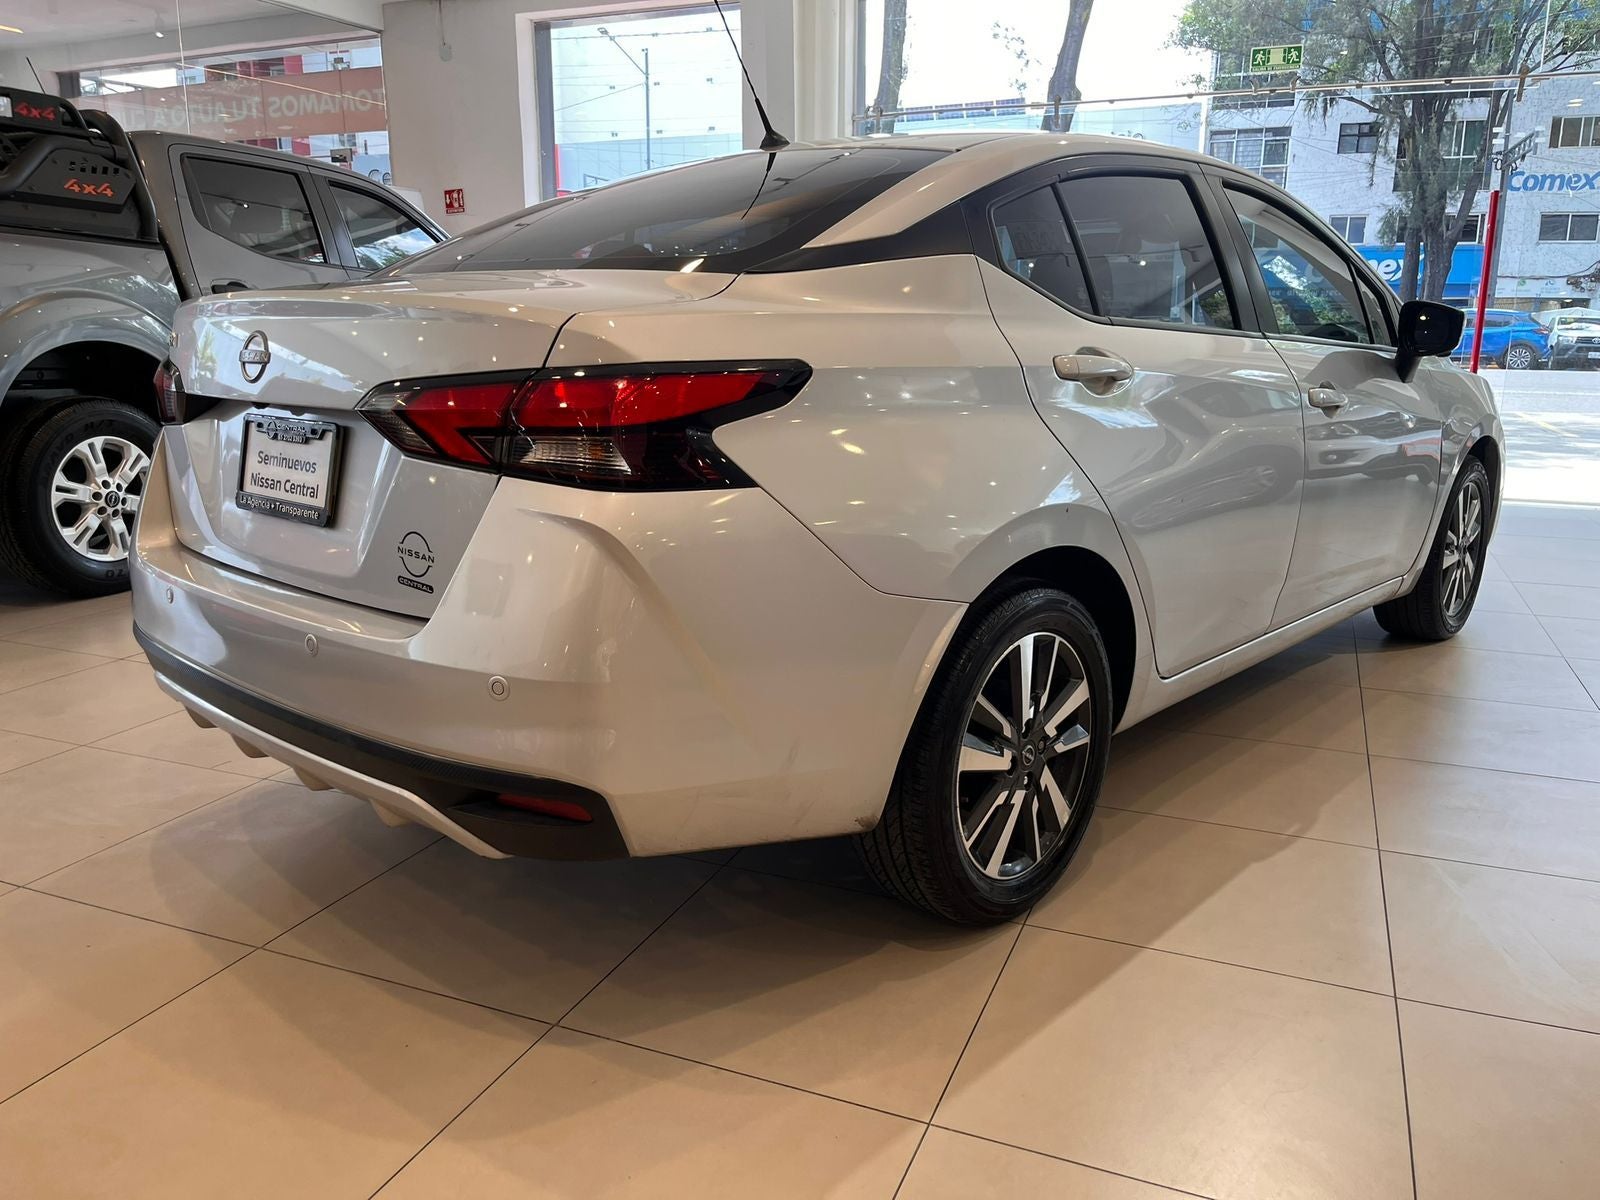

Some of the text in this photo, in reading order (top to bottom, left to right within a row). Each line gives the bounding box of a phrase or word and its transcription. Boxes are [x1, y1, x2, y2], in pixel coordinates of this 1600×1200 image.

[14, 102, 56, 120] 4x4
[64, 178, 114, 197] 4x4
[1507, 170, 1600, 192] Comex
[257, 450, 317, 474] Seminuevos
[250, 472, 319, 499] Nissan Central
[240, 495, 319, 520] La Agencia Transparente
[397, 546, 435, 563] NISSAN
[400, 577, 433, 593] CENTRAL
